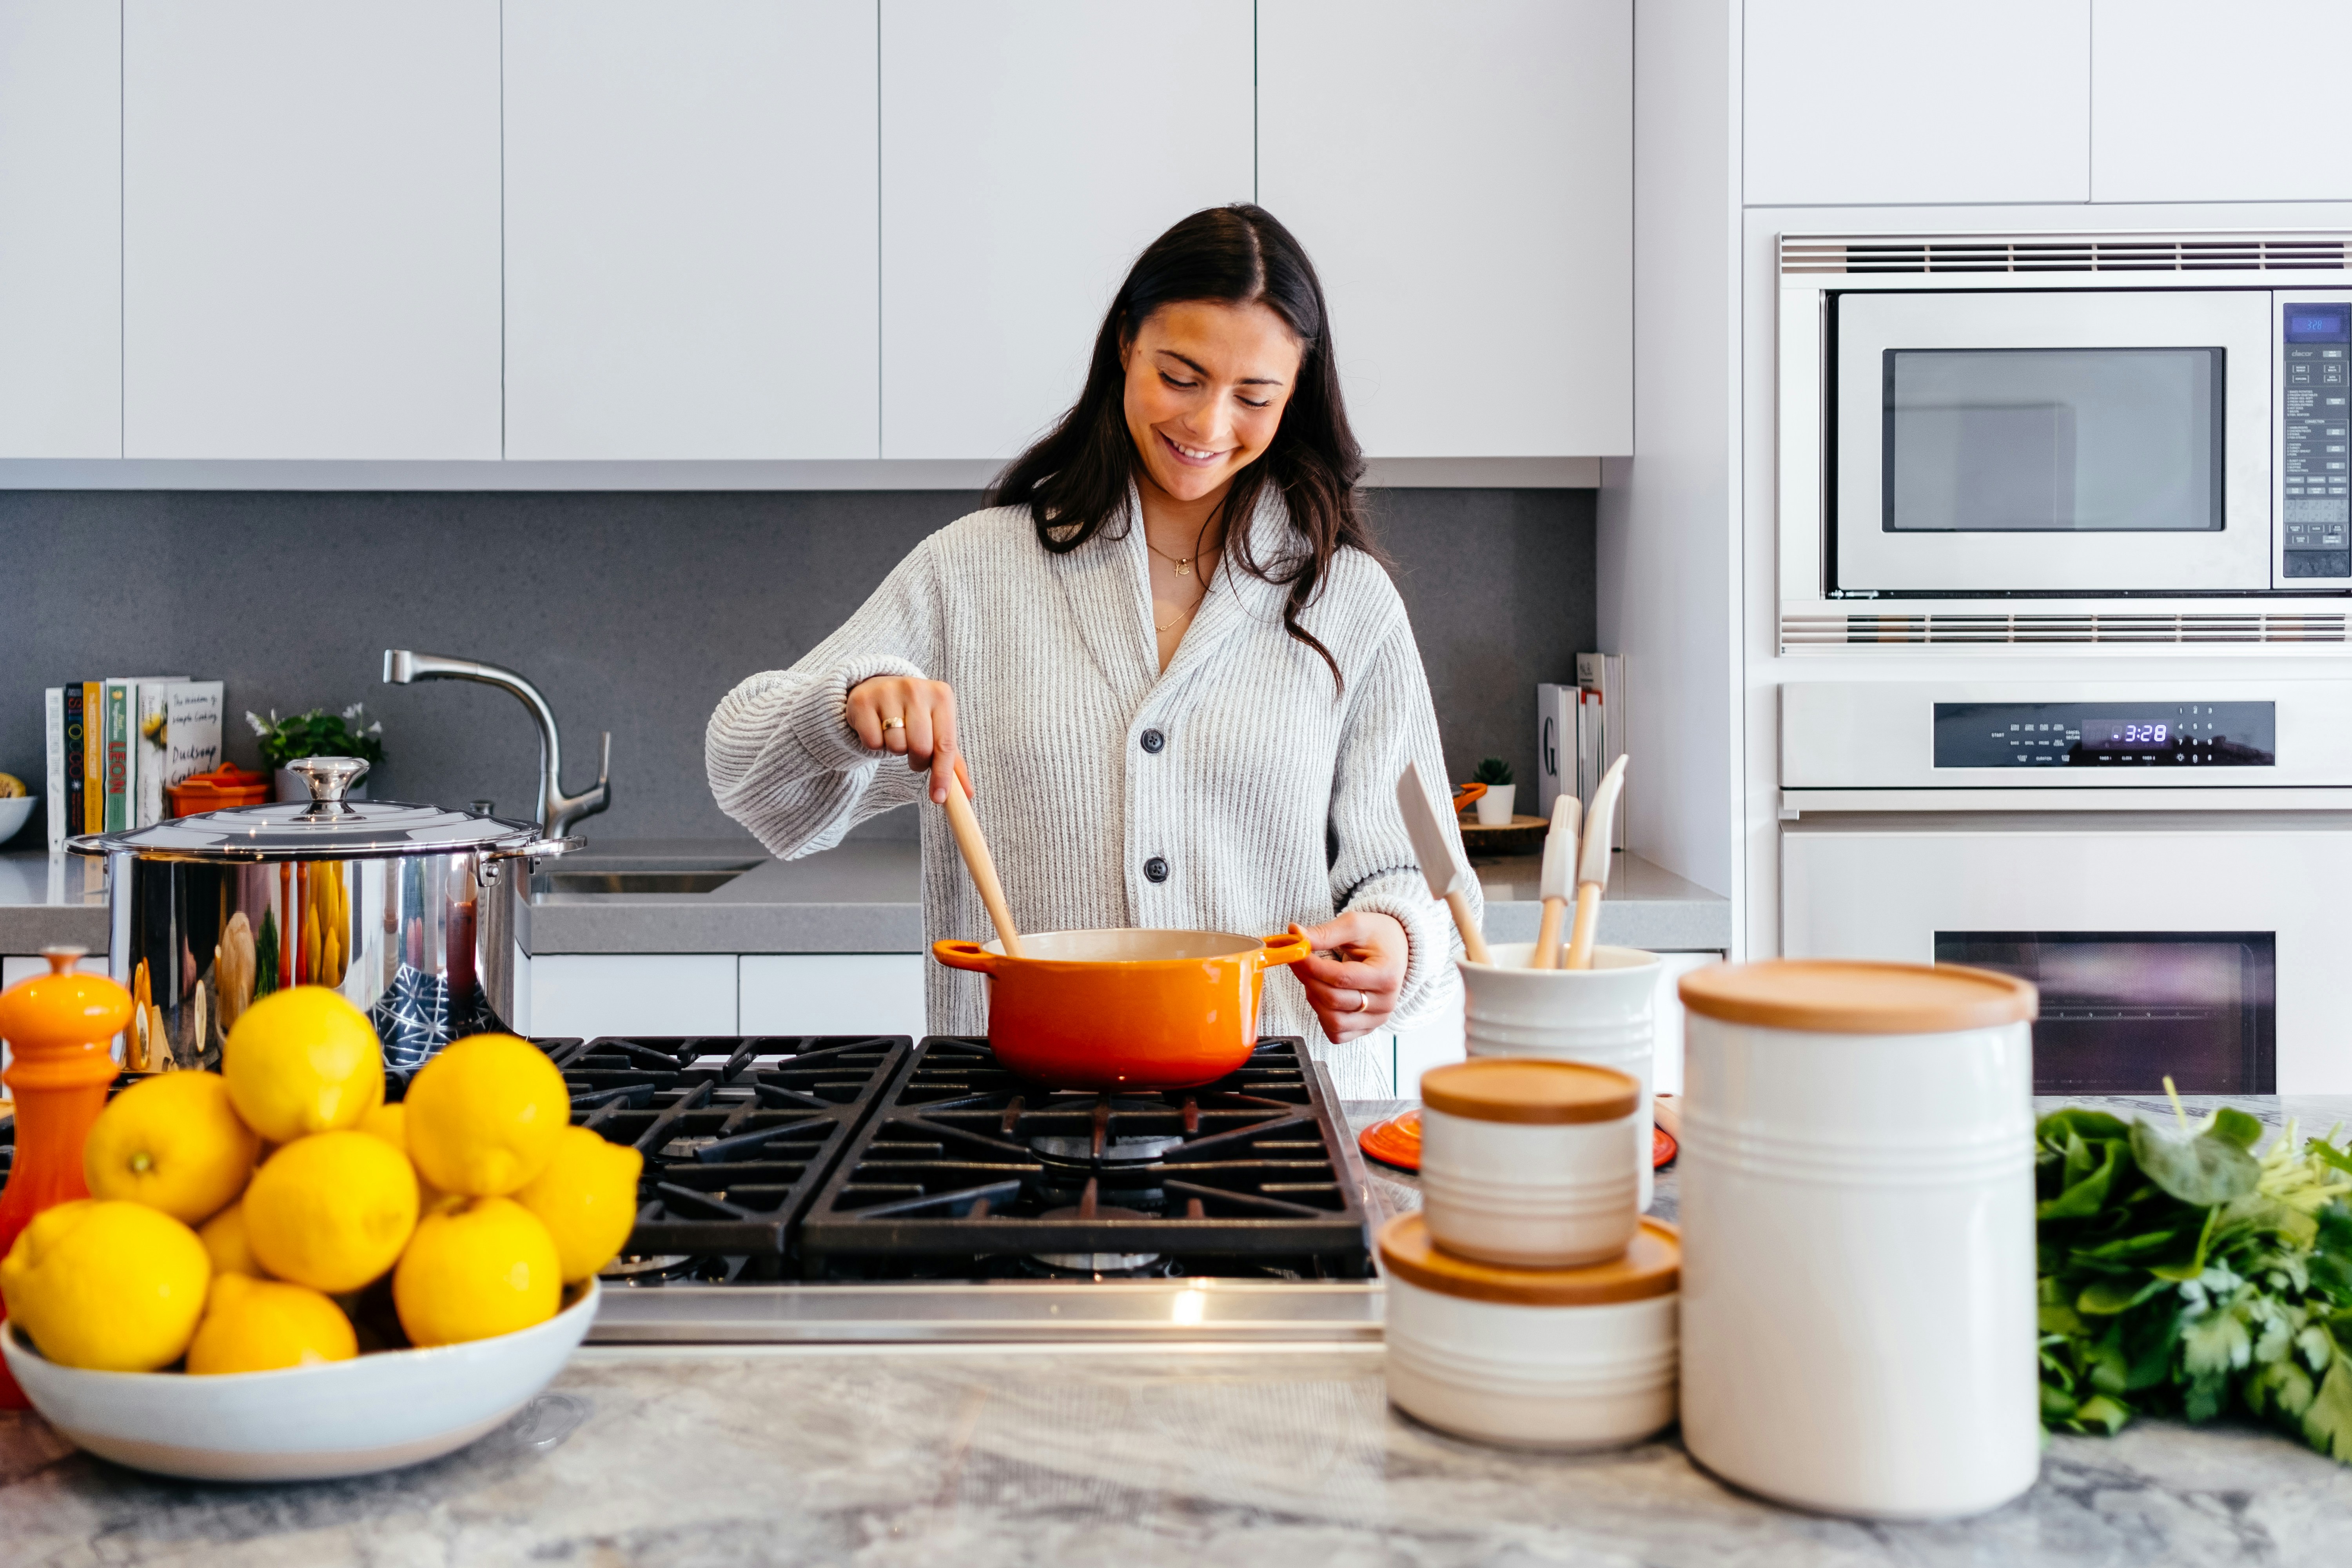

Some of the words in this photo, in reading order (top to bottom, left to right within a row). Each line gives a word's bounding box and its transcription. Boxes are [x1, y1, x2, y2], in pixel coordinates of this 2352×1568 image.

[2125, 724, 2167, 742] 3:28
[172, 744, 216, 763] Ducksoup
[109, 741, 126, 793] LEON
